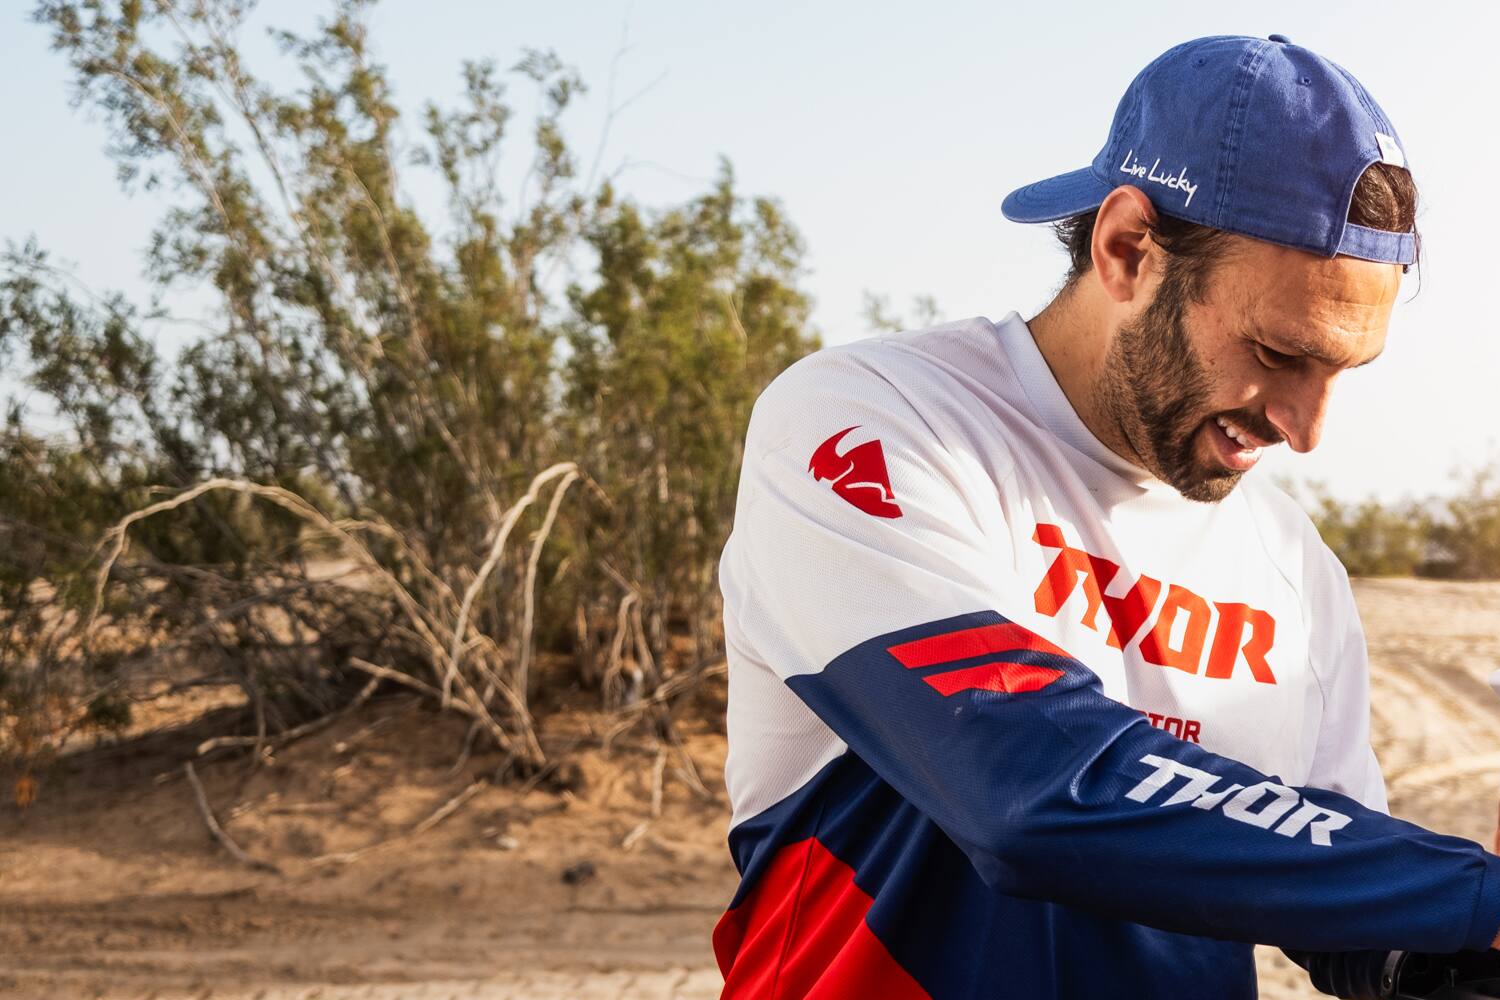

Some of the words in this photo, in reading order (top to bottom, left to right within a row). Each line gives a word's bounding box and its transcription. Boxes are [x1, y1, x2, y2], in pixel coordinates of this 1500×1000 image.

[1120, 149, 1147, 178] Live
[1147, 158, 1198, 207] Lucky
[1031, 523, 1277, 685] THOR
[1138, 709, 1201, 744] TOR
[1124, 753, 1353, 847] THOR
